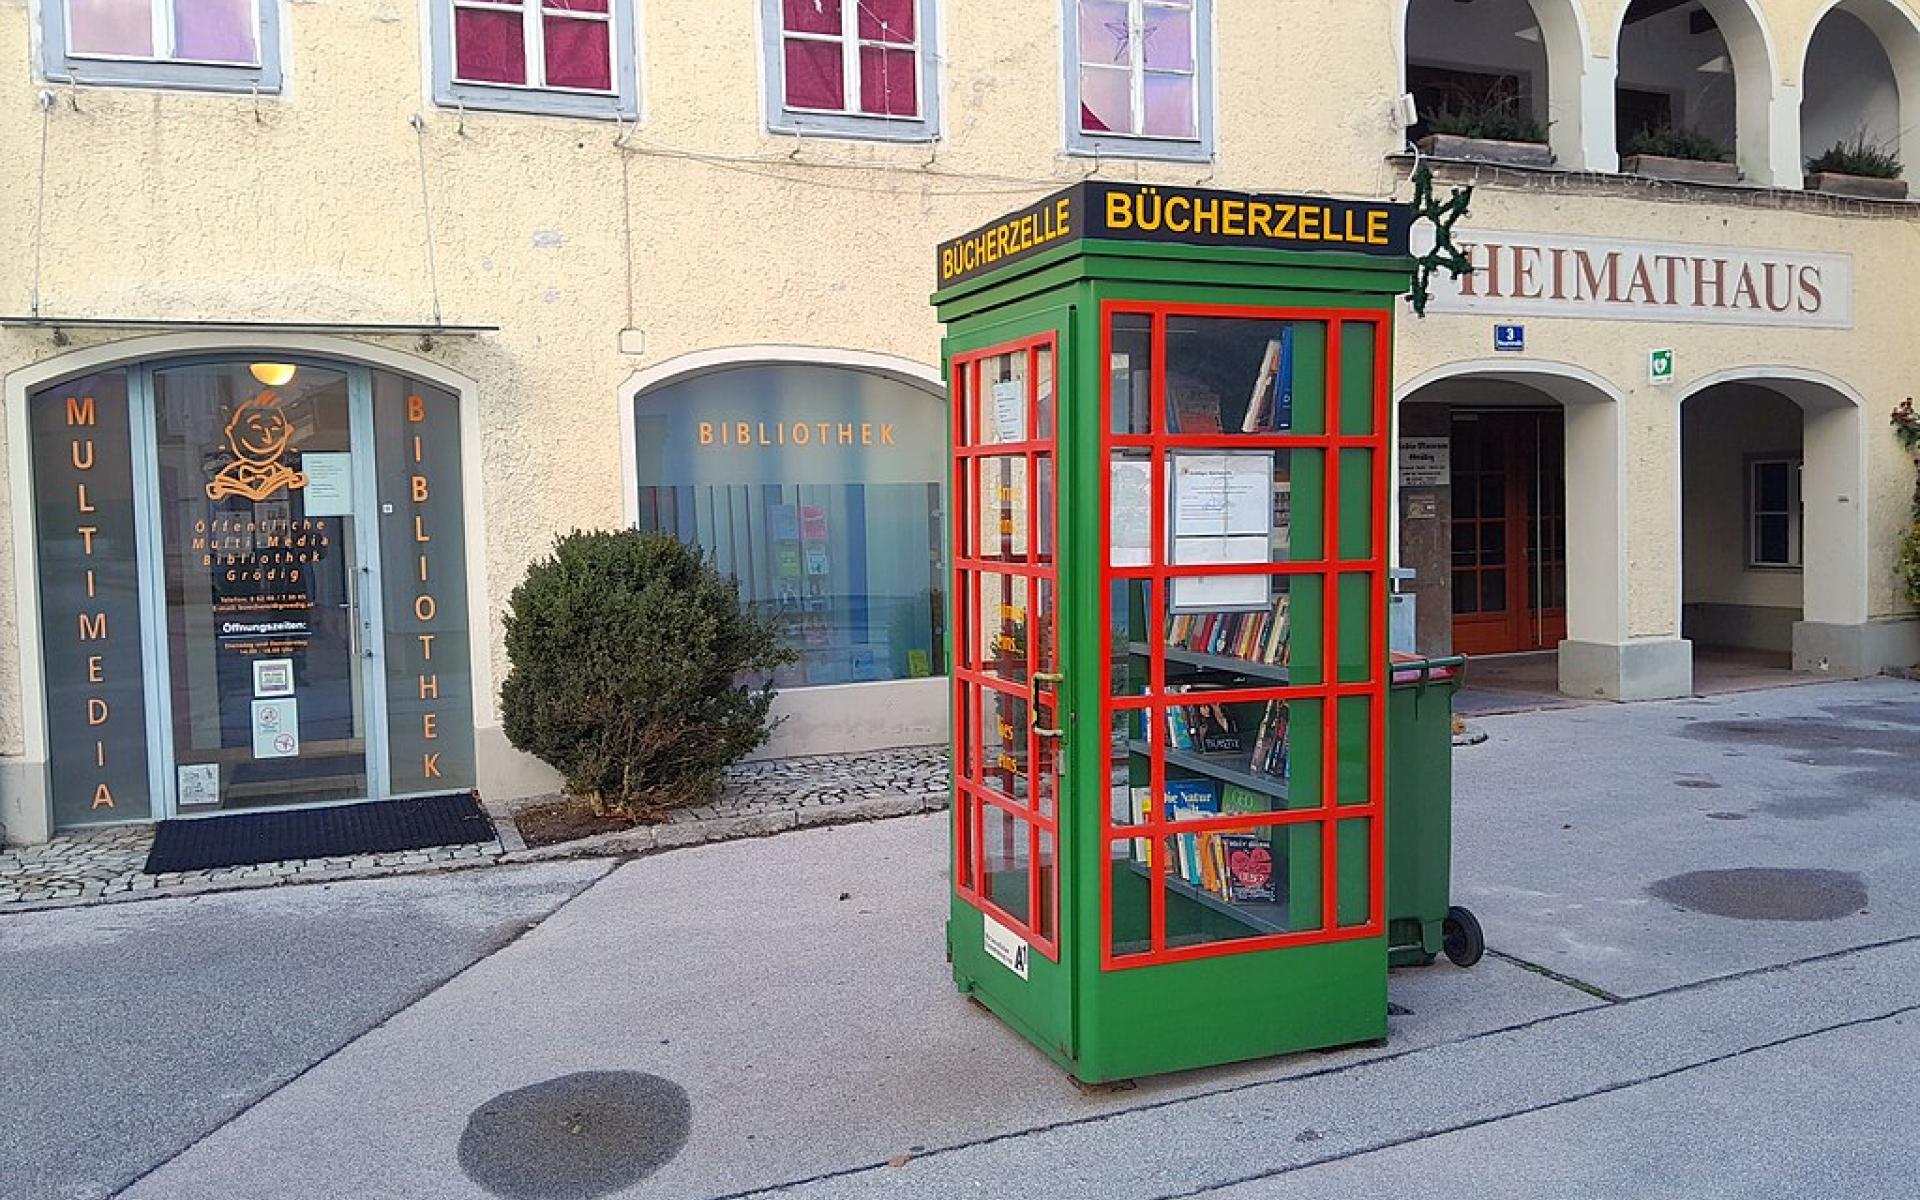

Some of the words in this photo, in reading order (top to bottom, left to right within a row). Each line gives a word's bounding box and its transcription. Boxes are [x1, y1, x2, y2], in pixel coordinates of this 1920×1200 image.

[1105, 187, 1390, 245] BÜCHERZELLE
[942, 198, 1071, 280] BÜCHERZELLE
[1457, 242, 1822, 313] HEIMATHAUS
[1505, 328, 1514, 340] 3
[699, 421, 896, 446] BIBLIOTHEK
[203, 551, 320, 566] Bibliothek
[226, 568, 300, 582] Grödig
[65, 397, 115, 810] MULTIMEDIA
[407, 396, 441, 779] BIBLIOTHEK
[222, 621, 307, 633] Öffnungszeiten:
